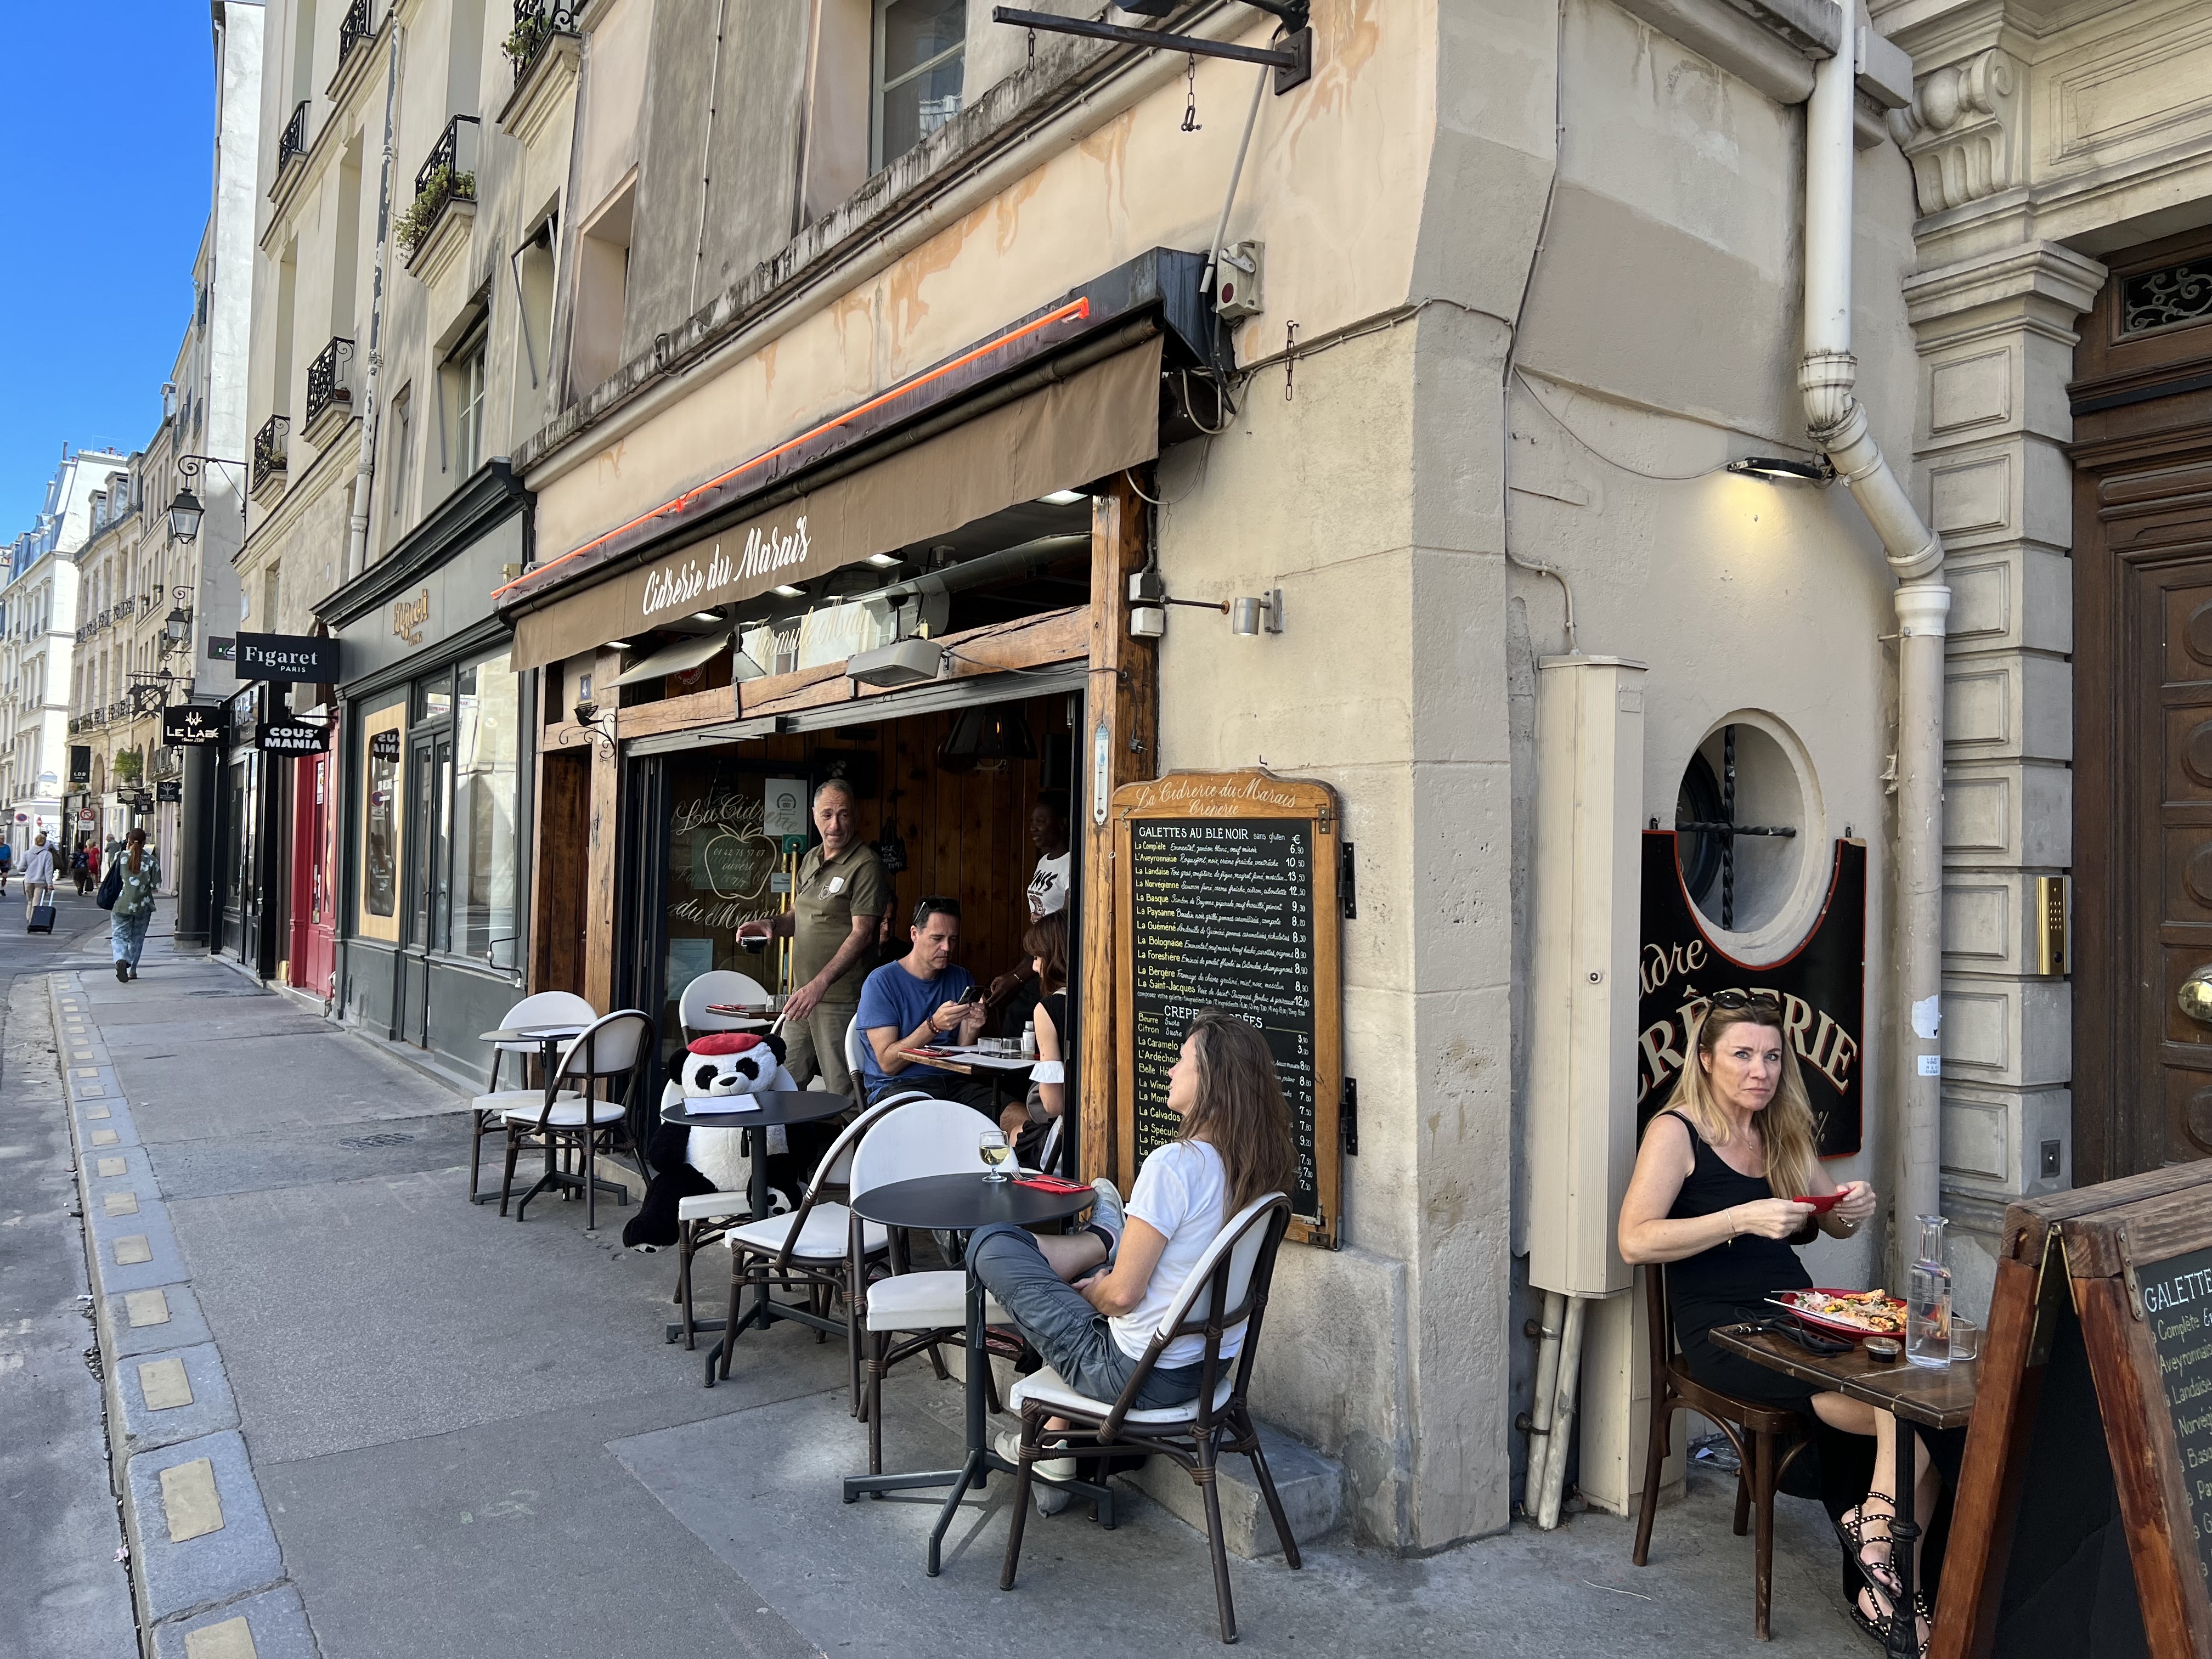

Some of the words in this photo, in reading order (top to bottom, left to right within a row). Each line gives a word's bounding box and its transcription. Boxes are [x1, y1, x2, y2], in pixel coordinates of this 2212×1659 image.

[643, 559, 706, 616] Cidrerie
[707, 543, 733, 591] du
[733, 515, 812, 582] Marais
[245, 646, 319, 667] Figaret
[166, 725, 184, 737] LE
[269, 726, 319, 738] COUS'
[264, 738, 322, 750] MANIA
[1134, 786, 1156, 812] La
[1159, 777, 1217, 803] Cidrerie
[1218, 778, 1236, 798] du
[1237, 777, 1297, 808] Marais
[1139, 826, 1188, 838] GALETTES
[1189, 827, 1202, 839] AU
[1225, 827, 1249, 840] NOIR
[1268, 832, 1286, 844] gluten
[1291, 834, 1301, 845] €
[1135, 840, 1142, 850] La
[1135, 866, 1143, 875] La
[1144, 866, 1170, 876] Landaise
[1136, 879, 1143, 887] La
[1144, 878, 1180, 891] Norvégienne
[1136, 892, 1144, 902] La
[1146, 893, 1169, 906] Basque
[1136, 906, 1145, 915] La
[1147, 906, 1175, 919] Paysanne
[1137, 920, 1146, 929] La
[1137, 935, 1146, 945] La
[1148, 935, 1183, 950] Bolognaise
[1137, 949, 1146, 958] La
[1148, 949, 1181, 962] Forestière
[1137, 964, 1147, 975] La
[1148, 966, 1176, 980] Bergère
[1639, 939, 1708, 1002] idre
[1137, 978, 1147, 988] La
[1149, 979, 1196, 996] Saint-Jacques
[1138, 1012, 1159, 1024] Beurre
[1164, 1005, 1200, 1020] CREPE
[1138, 1023, 1160, 1034] Citron
[1138, 1036, 1146, 1045] La
[1147, 1037, 1179, 1051] Caramelo
[1138, 1063, 1156, 1075] Belle
[1138, 1077, 1147, 1087] La
[1139, 1090, 1148, 1101] La
[1139, 1105, 1148, 1116] La
[1150, 1107, 1181, 1122] Calvados
[1139, 1120, 1148, 1132] La
[1139, 1133, 1149, 1144] La
[1138, 1145, 1149, 1156] La
[2158, 1314, 2200, 1343] Complète
